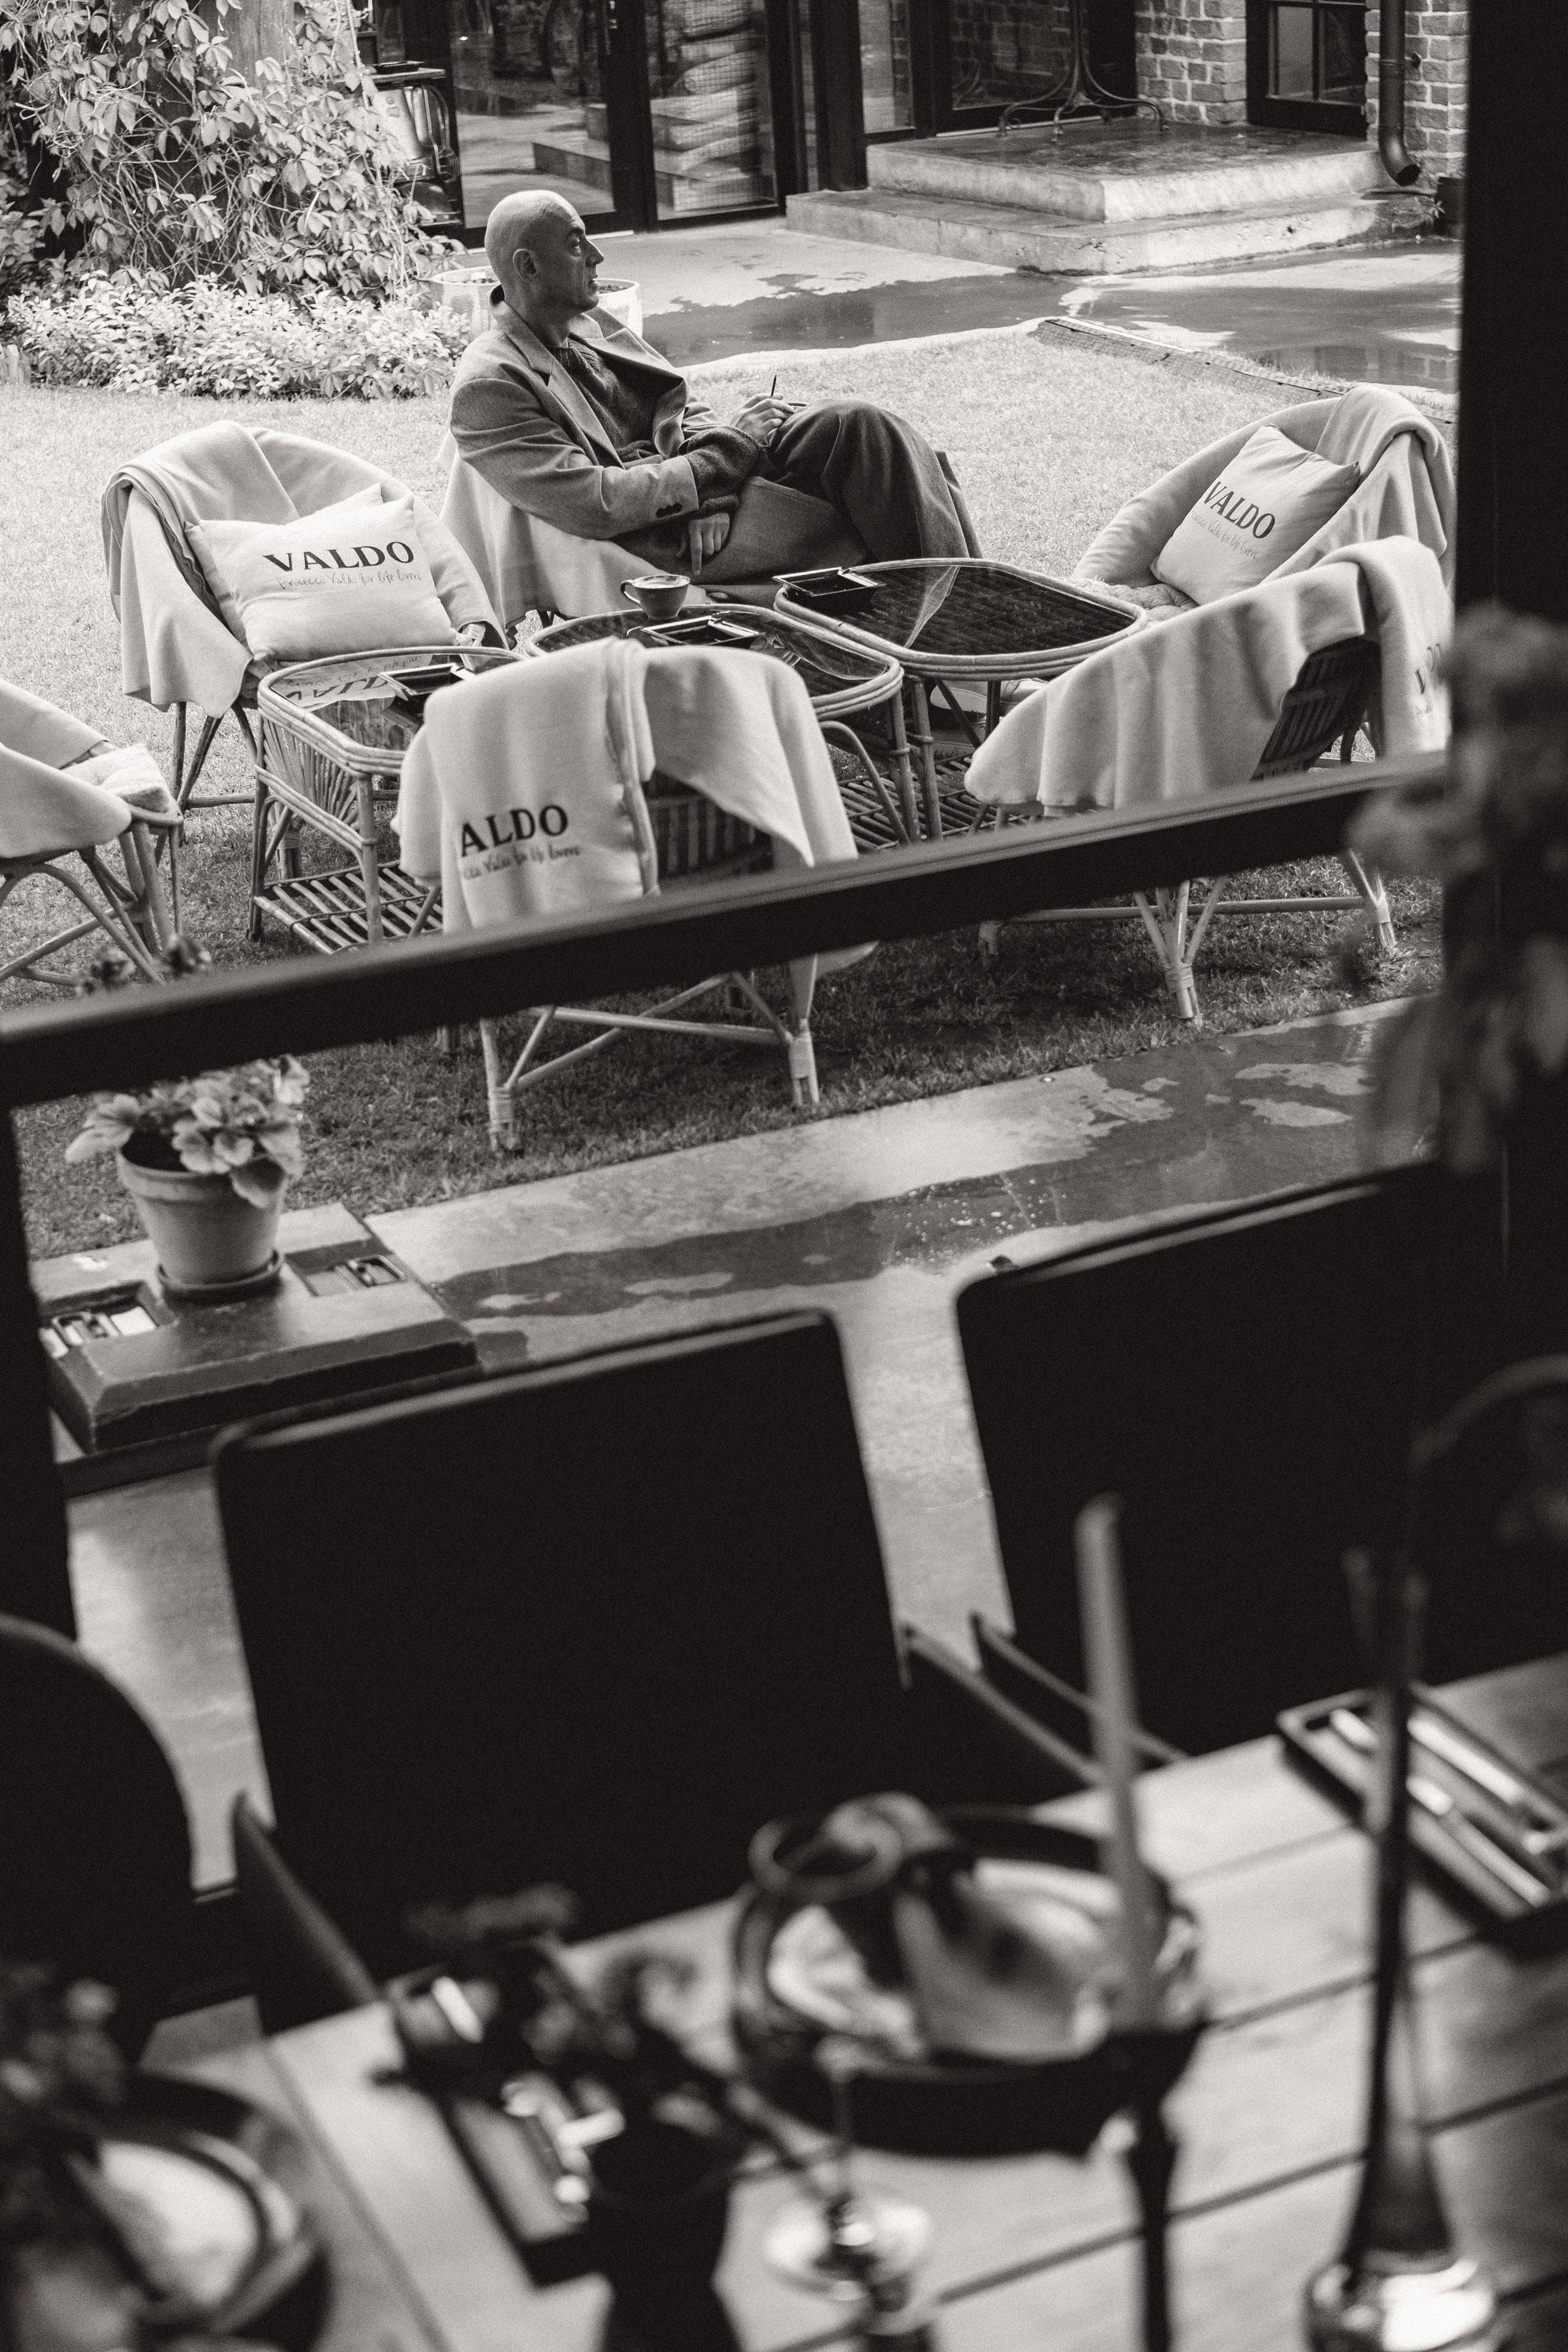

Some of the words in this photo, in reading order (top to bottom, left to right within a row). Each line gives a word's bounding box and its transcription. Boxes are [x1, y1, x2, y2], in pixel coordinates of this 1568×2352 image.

[1204, 481, 1275, 539] VALDO
[262, 541, 414, 571] VALDO
[326, 572, 357, 585] Valdo
[360, 572, 373, 586] for
[377, 570, 394, 584] life
[462, 805, 568, 858] ALDO
